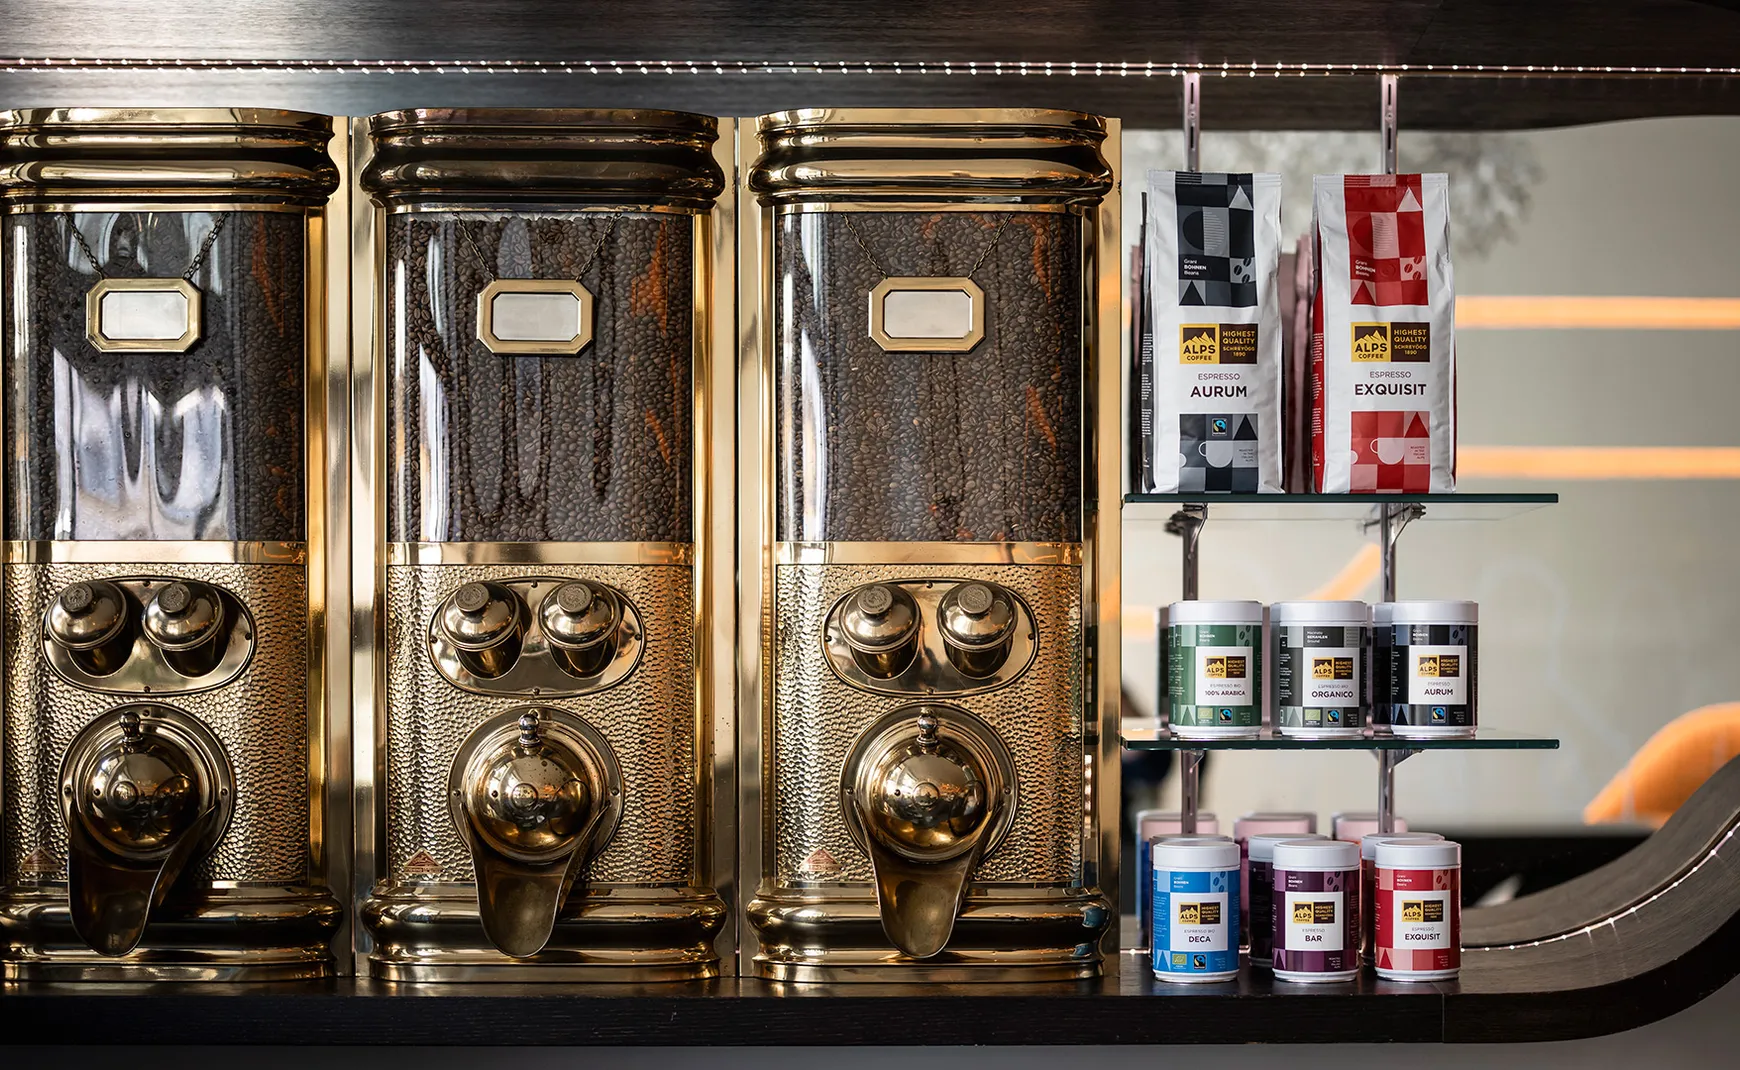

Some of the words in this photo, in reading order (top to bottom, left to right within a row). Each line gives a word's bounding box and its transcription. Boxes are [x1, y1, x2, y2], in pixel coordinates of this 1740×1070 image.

[1183, 345, 1215, 354] ALPS
[1355, 343, 1387, 352] ALPS
[1191, 386, 1247, 397] AURUM
[1355, 384, 1426, 395] EXQUISIT
